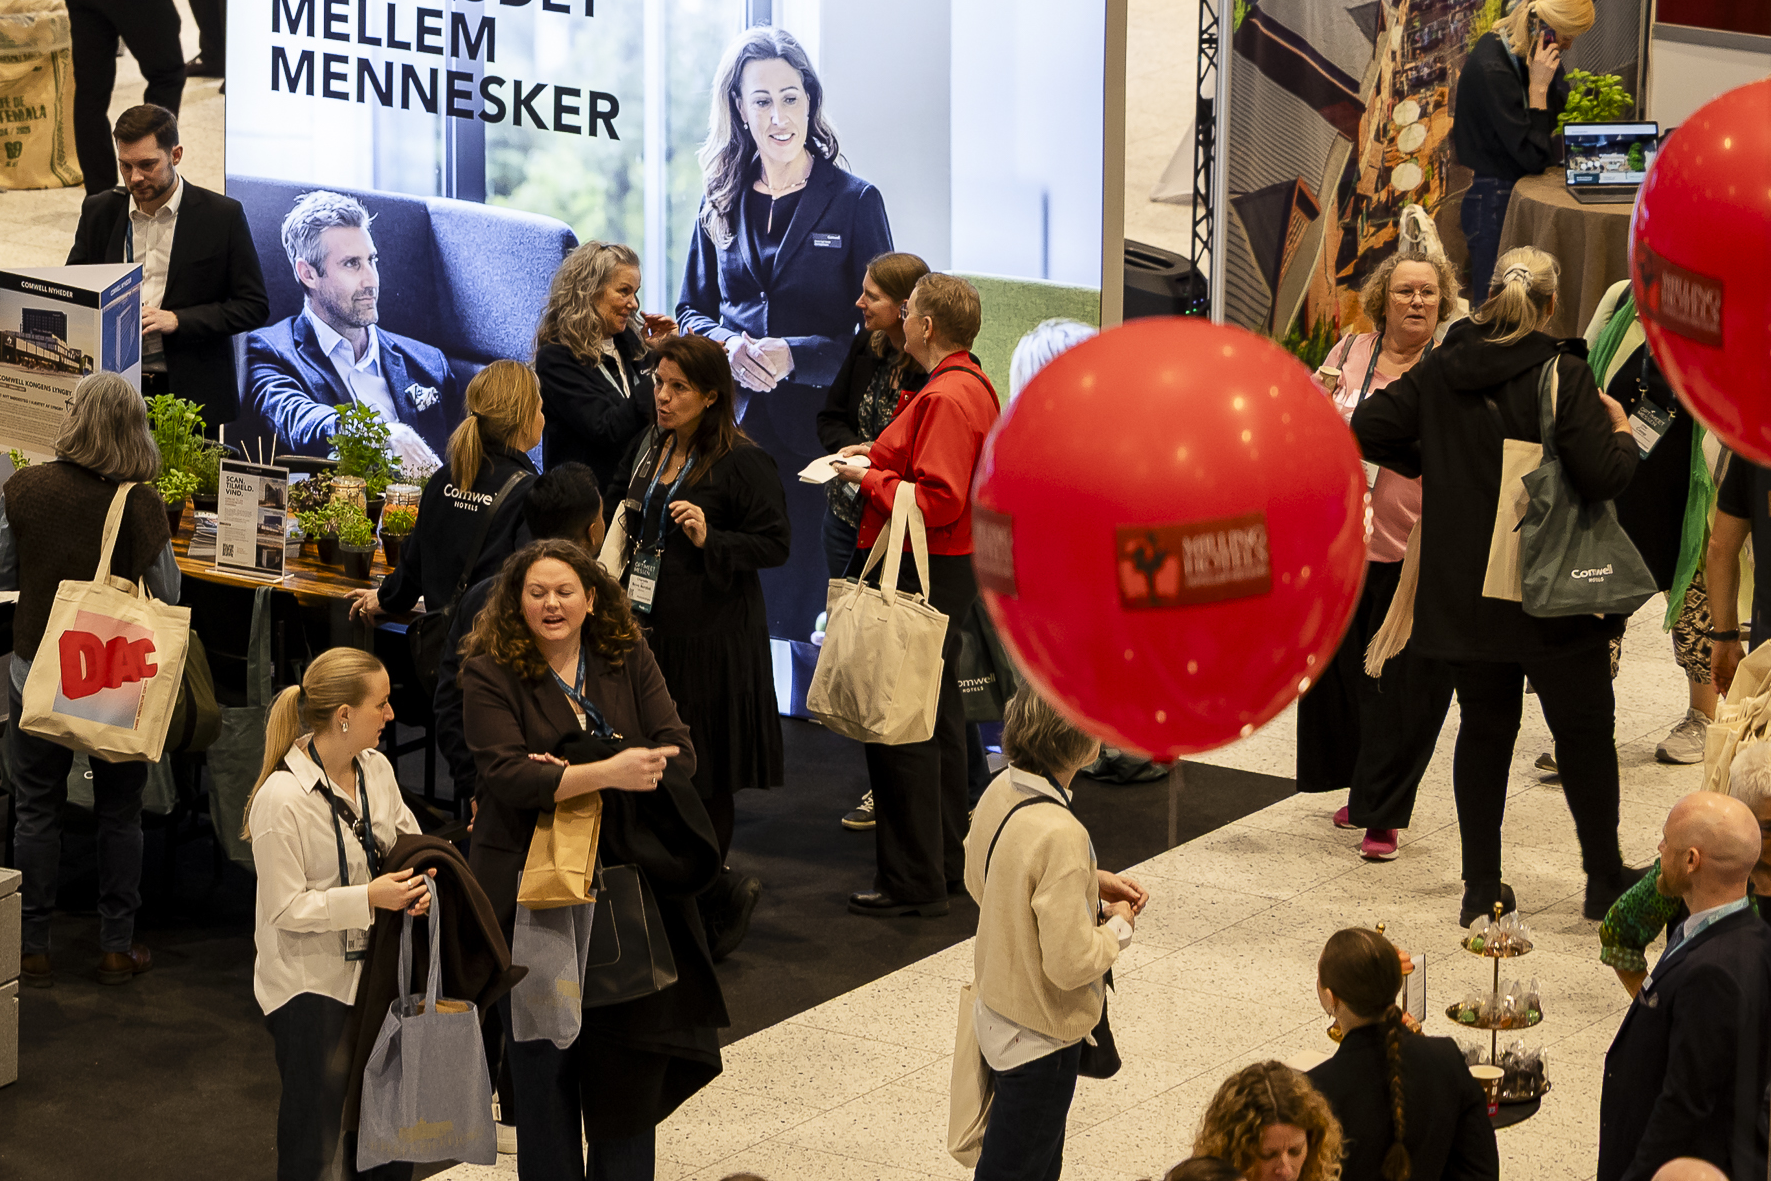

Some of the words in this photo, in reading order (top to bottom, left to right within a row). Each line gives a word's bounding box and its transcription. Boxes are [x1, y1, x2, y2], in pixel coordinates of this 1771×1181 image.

[13, 95, 25, 108] DE
[271, 45, 620, 141] MENNESKER
[21, 280, 48, 293] COMWELL
[48, 285, 74, 299] NYHEDER
[25, 380, 52, 392] KONGENS
[52, 385, 72, 397] LYNGBY
[443, 483, 500, 507] Comwe
[454, 501, 479, 512] HOTELS
[1571, 564, 1613, 579] Comwell
[58, 630, 158, 700] DAC
[958, 673, 996, 688] omwell
